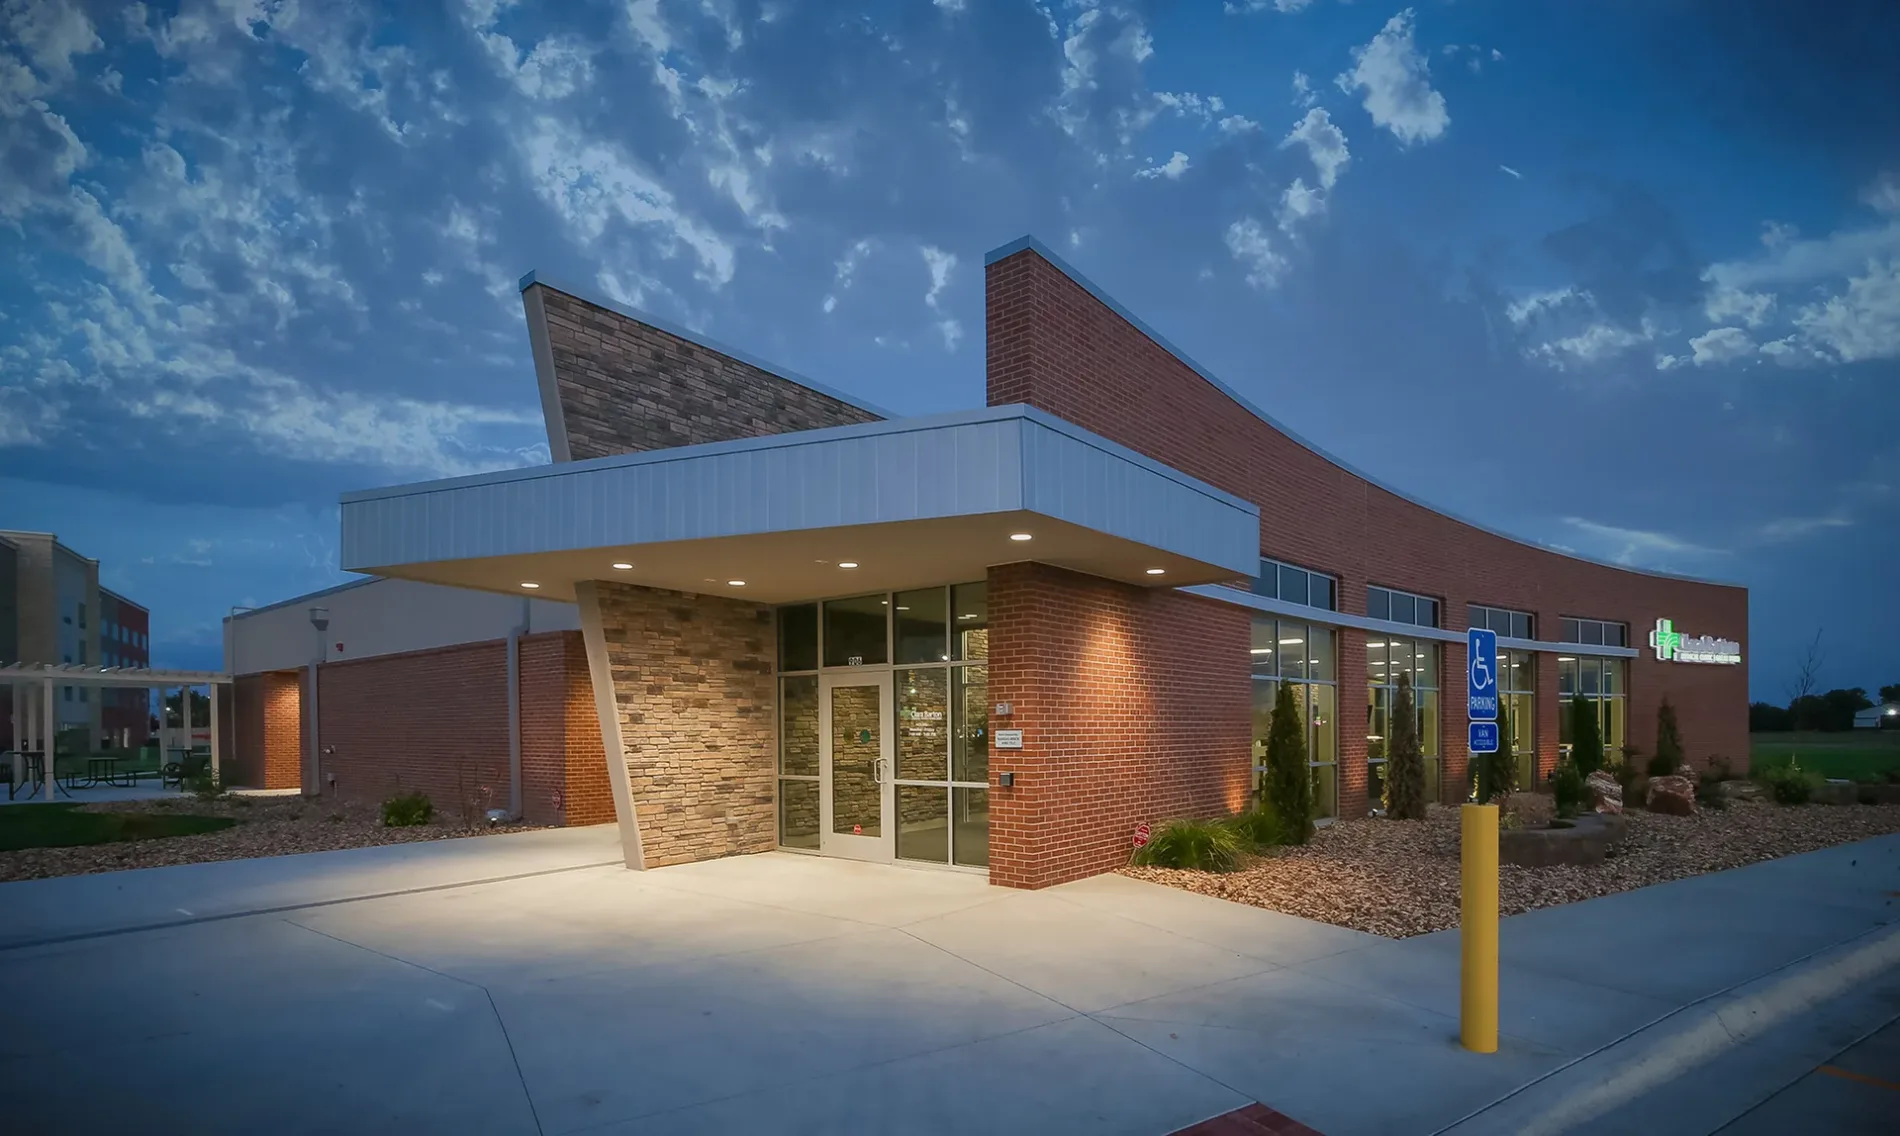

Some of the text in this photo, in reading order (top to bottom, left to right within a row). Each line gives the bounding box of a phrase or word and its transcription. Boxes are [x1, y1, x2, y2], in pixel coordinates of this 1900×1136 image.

[1470, 696, 1496, 711] PARKING
[911, 710, 942, 719] Clara Barton
[1478, 729, 1489, 738] VAN
